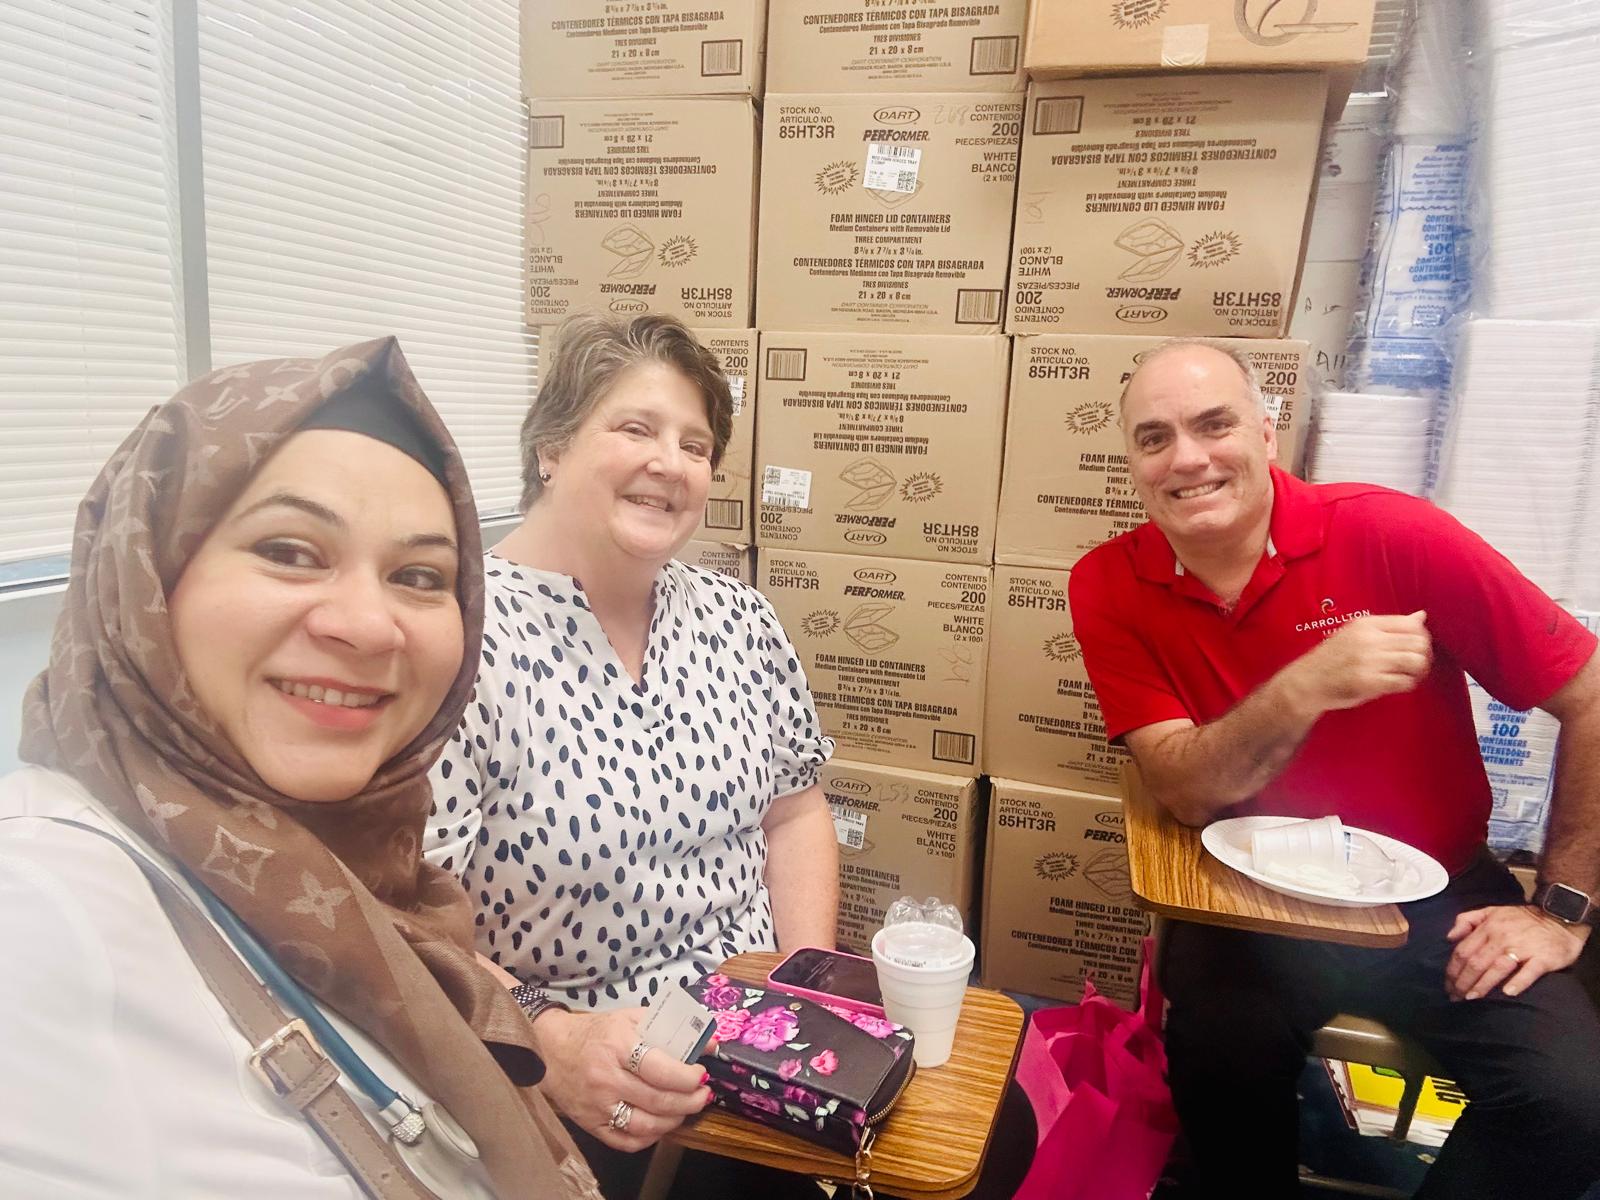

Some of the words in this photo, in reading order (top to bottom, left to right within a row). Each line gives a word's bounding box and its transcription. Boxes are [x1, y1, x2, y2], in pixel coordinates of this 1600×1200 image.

[803, 11, 864, 25] CONTENEDORES
[910, 8, 927, 20] CON
[929, 7, 949, 19] TAPA
[952, 5, 1000, 18] BISAGRADA
[779, 106, 806, 114] STOCK
[975, 104, 1022, 112] CONTENTS
[879, 110, 916, 120] DART
[970, 113, 1020, 121] CONTENIDO
[779, 125, 835, 139] 85HT3R
[992, 122, 1020, 136] 200
[955, 137, 1019, 146] PIECES/PIEZAS
[983, 152, 1017, 162] WHITE
[971, 163, 1016, 173] BLANCO
[1085, 201, 1141, 213] CONTAINERS
[1144, 201, 1160, 212] LID
[1161, 200, 1195, 211] HINGED
[1197, 200, 1225, 211] FOAM
[830, 214, 853, 223] FOAM
[855, 214, 884, 224] HINGED
[885, 214, 899, 224] LID
[900, 214, 951, 224] CONTAINERS
[855, 236, 874, 244] THREE
[875, 236, 922, 244] COMPARTMENT
[793, 258, 852, 269] CONTENEDORES
[897, 259, 913, 269] CON
[916, 259, 935, 269] TAPA
[938, 259, 985, 270] BISAGRADA
[1019, 255, 1063, 265] BLANCO
[1018, 267, 1051, 277] WHITE
[877, 281, 909, 289] DIVISIONES
[1017, 282, 1080, 290] PIECES/PIEZAS
[530, 286, 550, 298] 200
[681, 287, 732, 299] 85HT3R
[1015, 291, 1043, 305] 200
[1213, 292, 1281, 307] 85HT3R
[615, 303, 645, 311] DART
[1014, 306, 1064, 314] CONTENIDO
[1014, 314, 1060, 323] CONTENTS
[1122, 310, 1161, 319] DART
[1031, 347, 1059, 356] STOCK
[725, 356, 748, 368] 200
[1028, 365, 1090, 380] 85HT3R
[1265, 372, 1297, 386] 200
[783, 398, 825, 409] BISAGRADA
[828, 399, 844, 409] TAPA
[849, 400, 863, 410] CON
[906, 401, 967, 412] CONTENEDORES
[814, 441, 859, 451] CONTAINERS
[861, 442, 874, 452] LID
[875, 443, 903, 453] HINGED
[905, 444, 928, 454] FOAM
[1108, 454, 1129, 465] HING
[1037, 495, 1103, 508] CONTENEDORES
[761, 512, 782, 524] 200
[761, 525, 801, 533] CONTENIDO
[923, 522, 979, 537] 85HT3R
[760, 532, 798, 540] CONTENTS
[850, 533, 882, 544] DART
[702, 551, 740, 559] CONTENTS
[951, 545, 978, 554] STOCK
[698, 558, 740, 567] CONTENIDO
[769, 559, 793, 568] STOCK
[769, 575, 820, 590] 85HT3R
[858, 572, 891, 582] DART
[945, 573, 988, 583] CONTENTS
[940, 581, 987, 591] CONTENIDO
[961, 591, 986, 604] 200
[927, 601, 985, 613] PIECES/PIEZAS
[1008, 595, 1066, 612] 85HT3R
[953, 615, 985, 626] WHITE
[1295, 609, 1370, 632] CARROLLTON
[943, 624, 984, 635] BLANCO
[815, 653, 836, 664] FOAM
[838, 655, 864, 667] HINGED
[866, 658, 878, 668] LID
[879, 659, 926, 673] CONTAINERS
[838, 674, 855, 683] THREE
[857, 676, 900, 688] COMPARTMENT
[877, 698, 893, 709] CON
[894, 699, 912, 711] TAPA
[914, 702, 958, 716] BISAGRADA
[1018, 713, 1081, 730] CONTENEDORES
[1490, 713, 1527, 724] CONTENU
[1492, 723, 1520, 738] 100
[835, 780, 866, 793] DART
[918, 789, 959, 802] CONTENTS
[914, 796, 959, 809] CONTENIDO
[934, 808, 958, 822] 200
[901, 814, 957, 830] PIECES/PIEZAS
[998, 815, 1056, 832] 85HT3R
[927, 830, 956, 842] WHITE
[1084, 828, 1127, 844] PERFO
[916, 837, 956, 851] BLANCO
